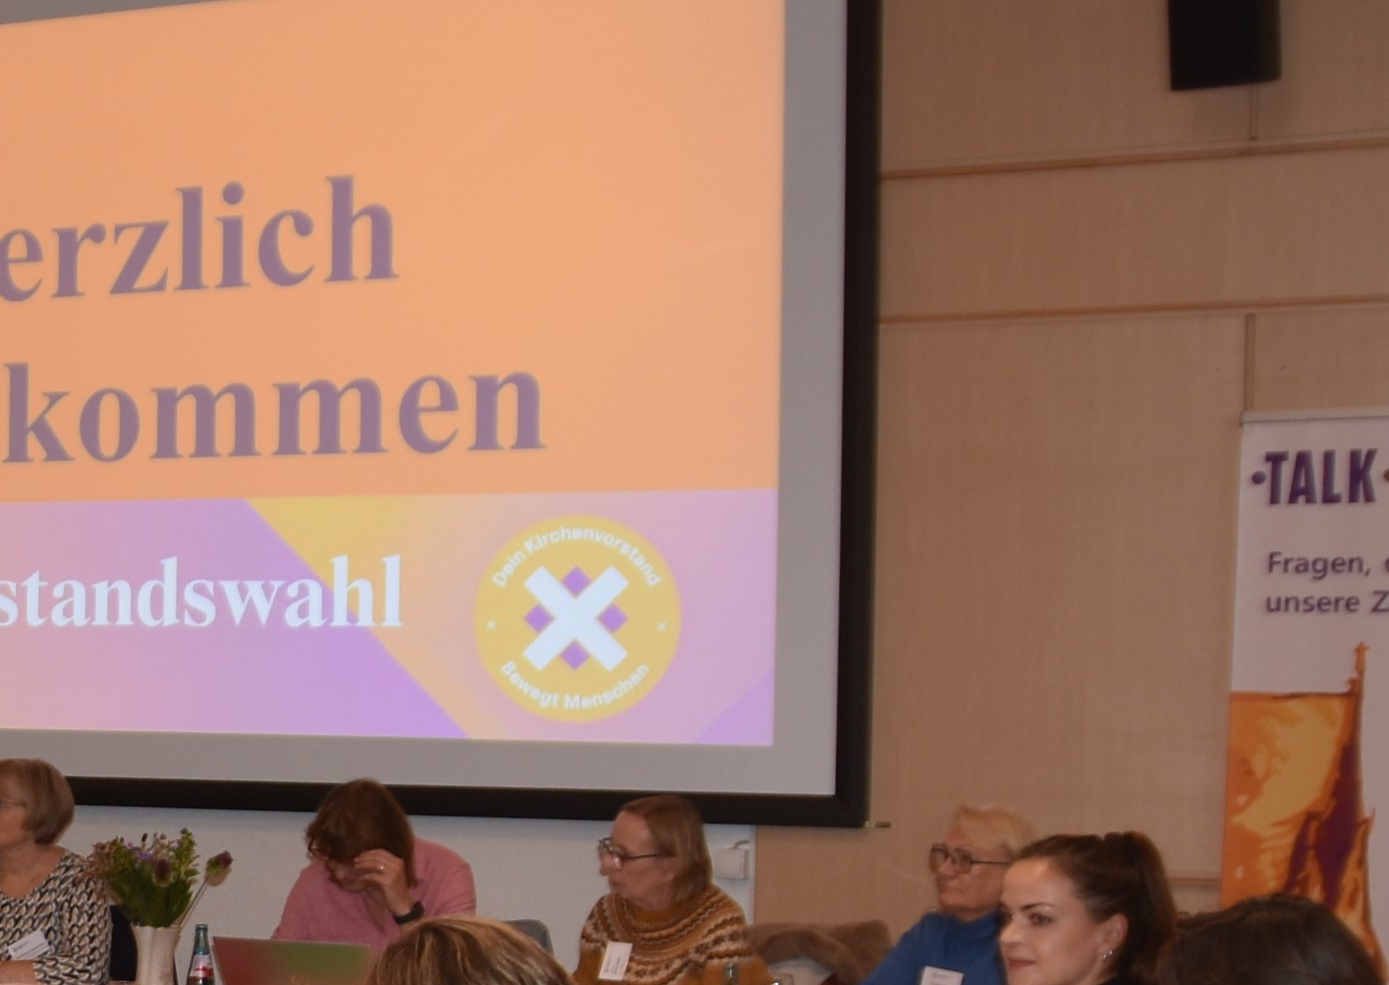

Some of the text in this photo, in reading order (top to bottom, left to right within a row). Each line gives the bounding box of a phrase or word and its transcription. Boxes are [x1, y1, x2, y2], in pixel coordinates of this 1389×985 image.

[1265, 448, 1378, 505] TALK
[492, 526, 663, 587] Dein Kirchenvorstand
[1266, 551, 1371, 580] Fragen,
[1265, 595, 1361, 613] unsere
[500, 660, 650, 710] Bewegt Menschen
